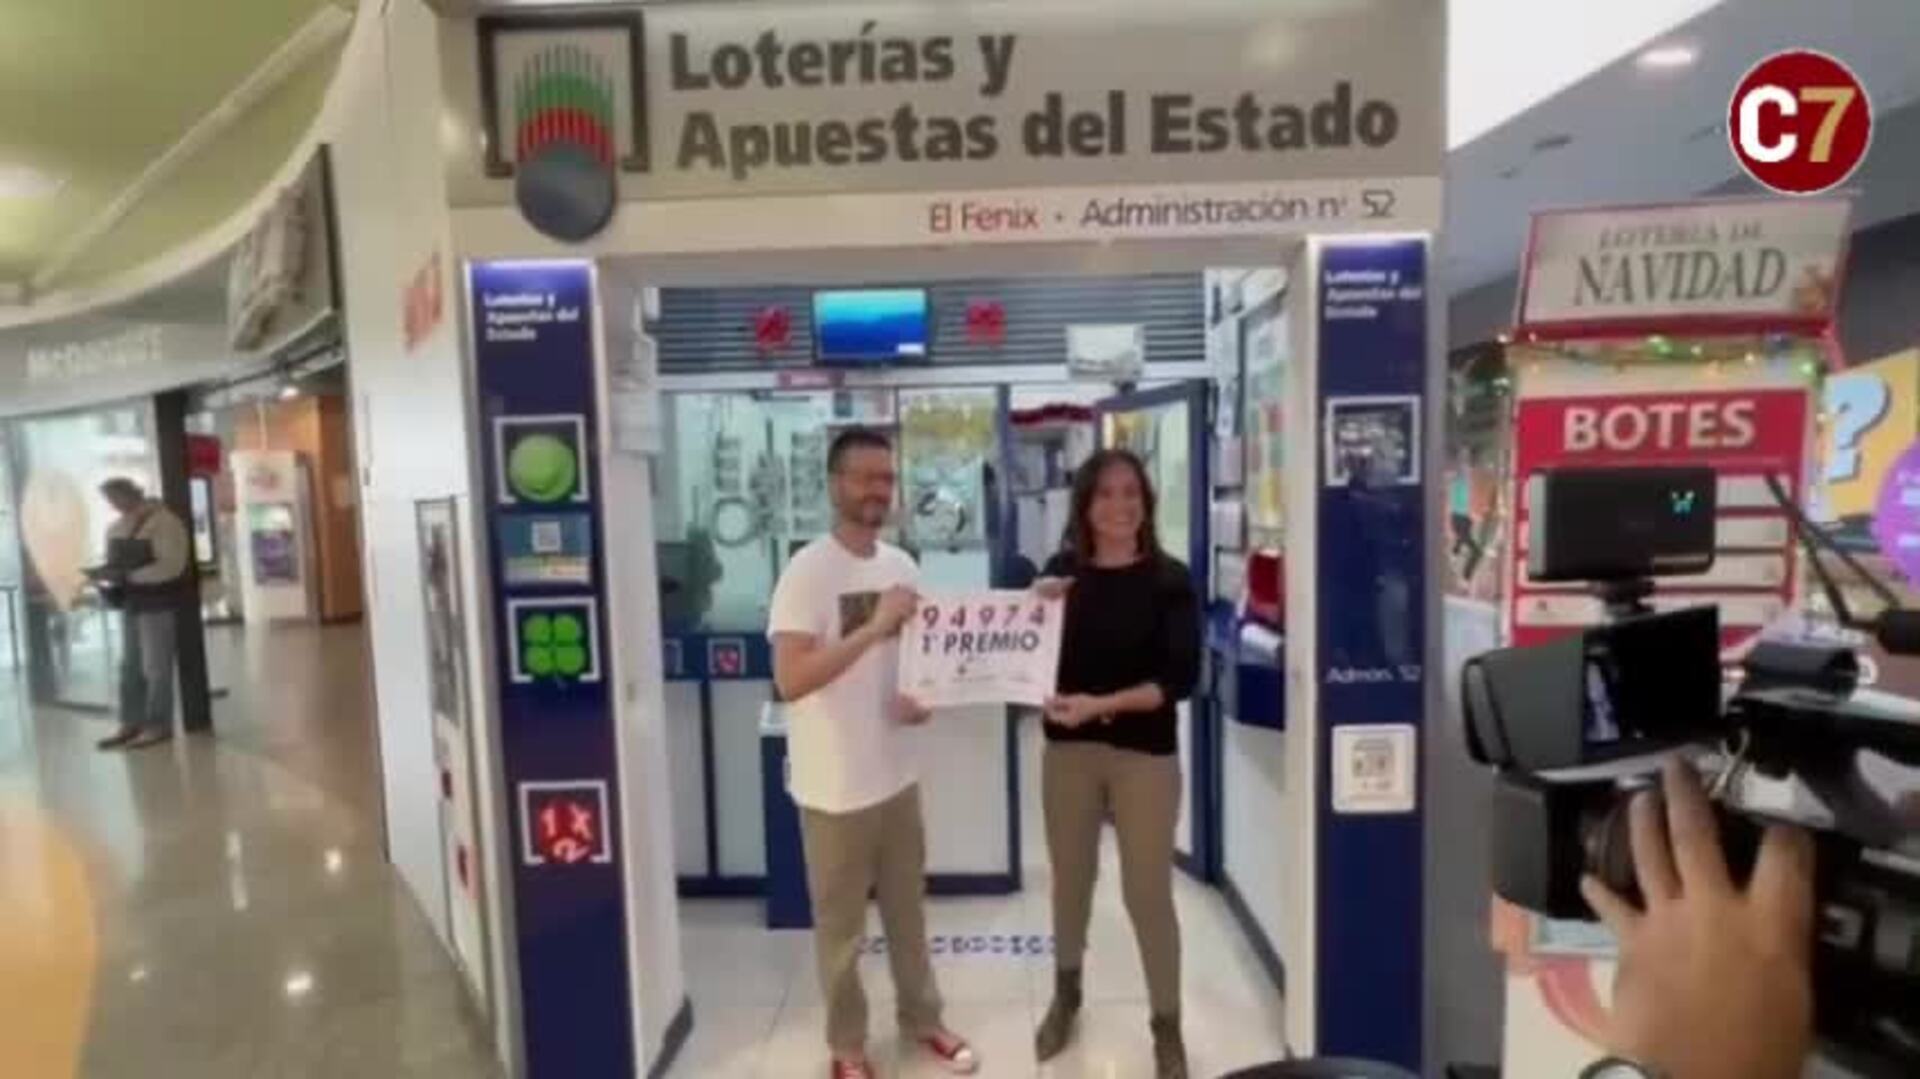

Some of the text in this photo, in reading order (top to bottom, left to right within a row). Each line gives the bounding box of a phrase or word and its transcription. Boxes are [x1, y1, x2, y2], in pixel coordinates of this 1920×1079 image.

[668, 20, 1018, 96] Loterías y
[677, 80, 1399, 179] Apuestas del Estado
[929, 205, 951, 233] El
[1079, 195, 1308, 228] Administración
[1362, 190, 1397, 219] 52
[1573, 247, 1788, 307] NAVIDAD
[1563, 401, 1756, 452] BOTES
[943, 630, 1040, 654] PREMIO
